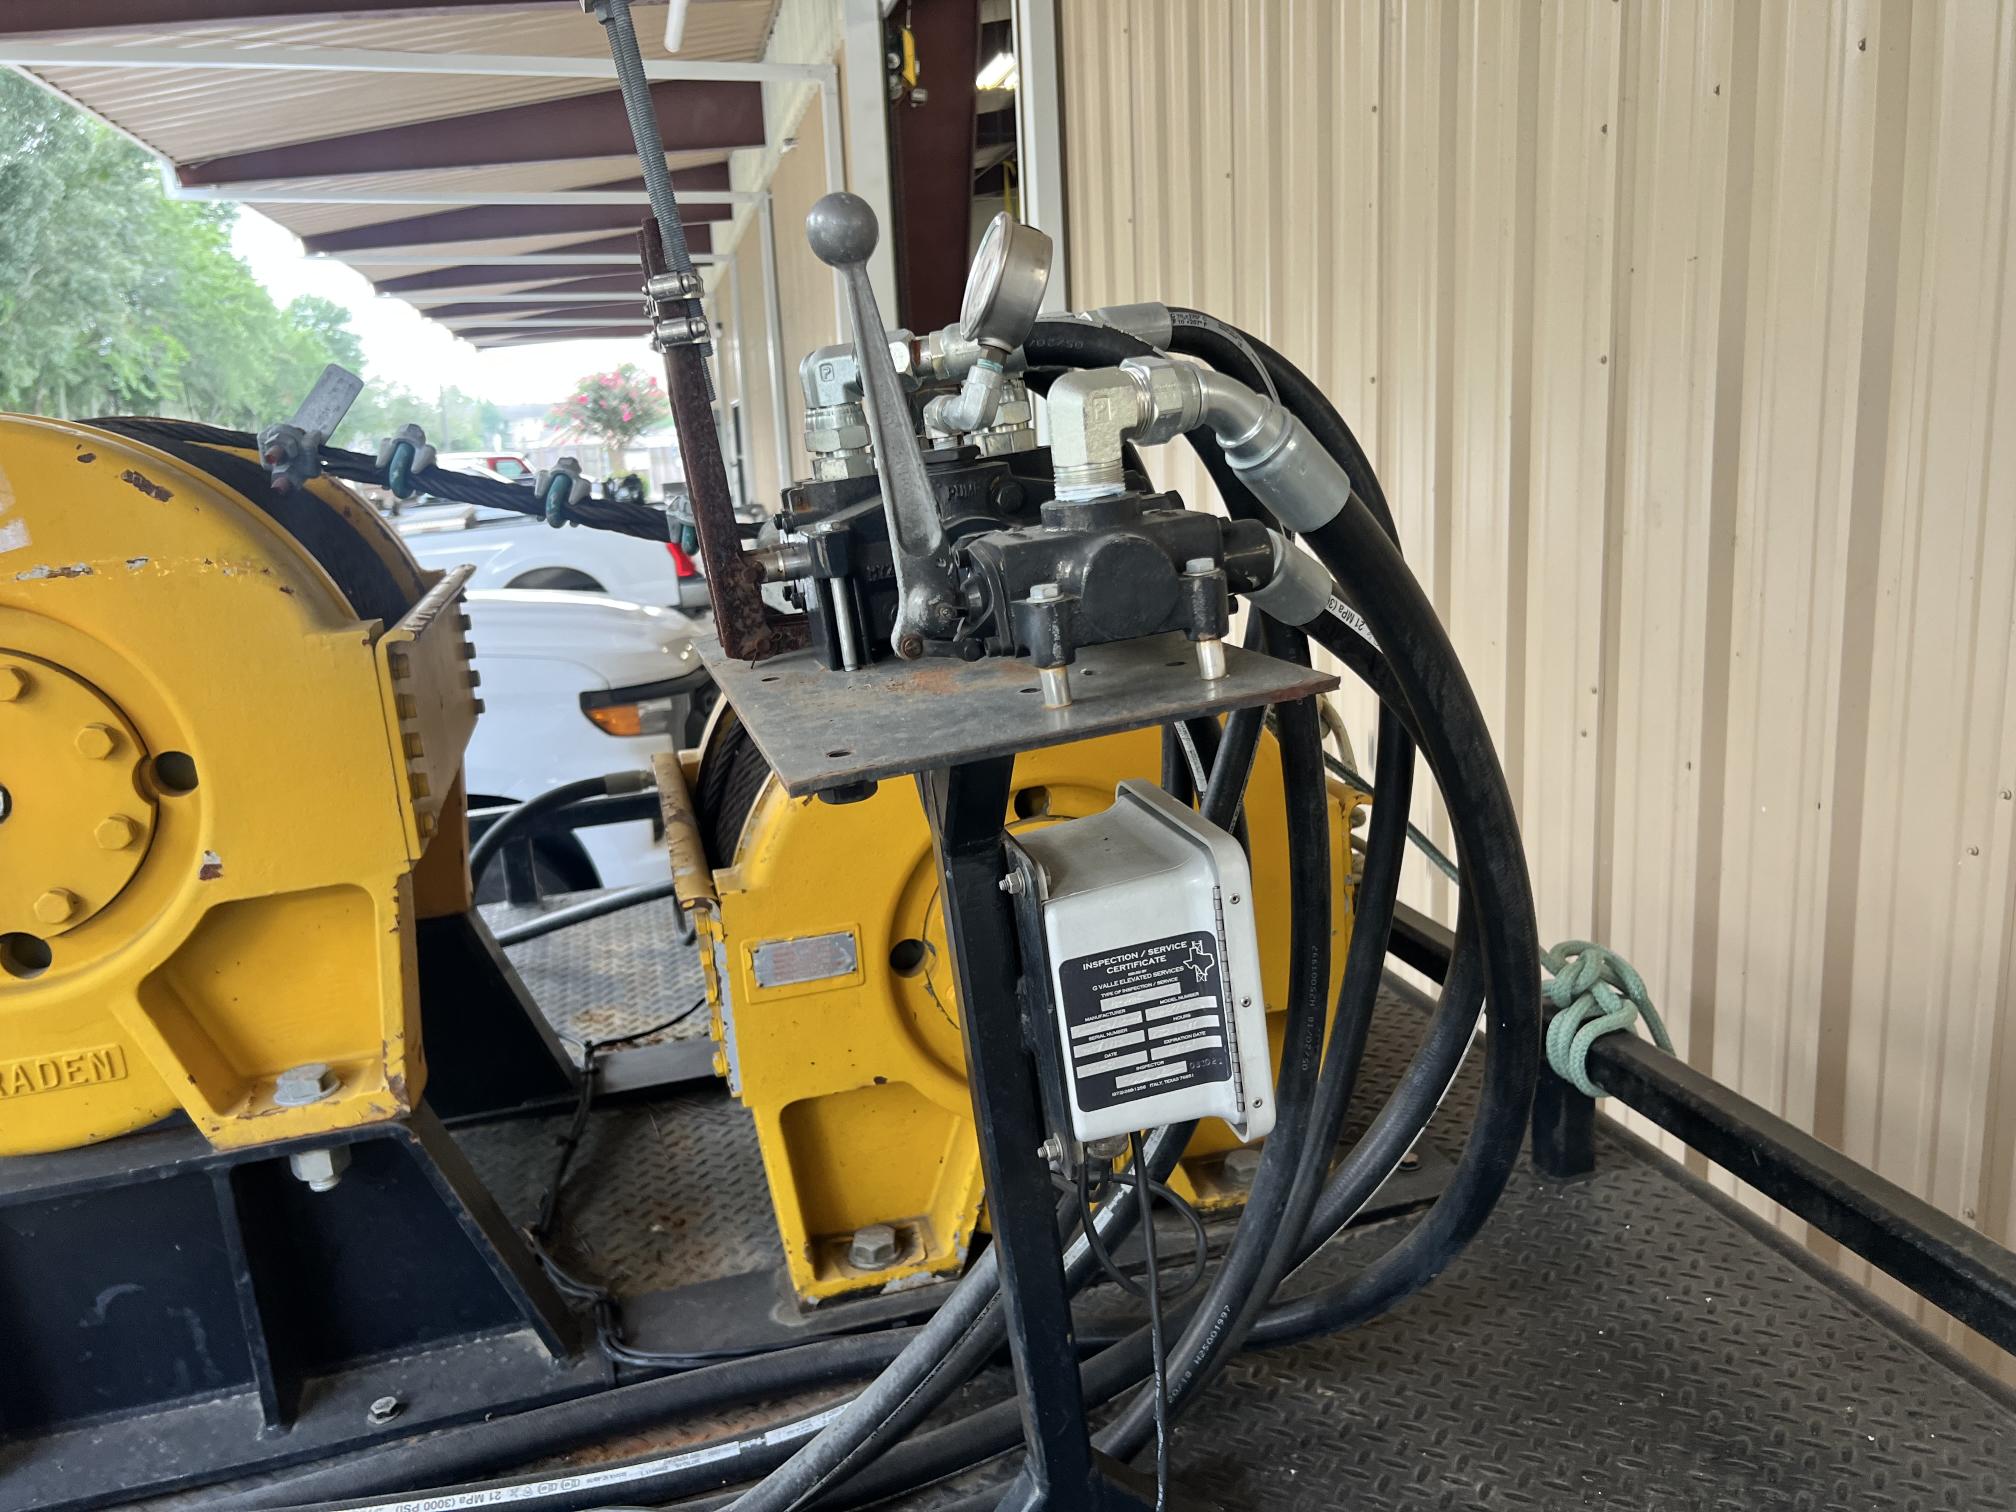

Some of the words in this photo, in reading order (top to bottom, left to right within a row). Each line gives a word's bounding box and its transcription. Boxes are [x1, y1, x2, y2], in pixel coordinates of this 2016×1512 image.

[1327, 597, 1338, 611] (3
[1338, 605, 1355, 623] MPa
[1354, 618, 1366, 631] 21
[1083, 950, 1139, 971] INSPECTION
[1147, 940, 1188, 956] SERVICE
[1106, 955, 1167, 974] CERTIFICATE
[1097, 980, 1119, 991] VALLE
[1119, 972, 1152, 985] ELEVATED
[1152, 965, 1185, 978] SERVICES
[1121, 982, 1153, 994] INSPECTION
[1156, 976, 1179, 987] SERVICE
[1159, 996, 1178, 1005] MODEL
[1177, 991, 1200, 1000] NUMBER
[1084, 1008, 1126, 1022] MANUFACTURER
[1088, 1033, 1106, 1042] SERIAL
[1106, 1028, 1128, 1037] NUMBER
[1163, 1034, 1193, 1045] EXPIRATION
[1192, 1030, 1207, 1038] DATE
[1104, 1051, 1118, 1059] DATE
[1135, 1060, 1165, 1071] INSPECTOR
[458, 1493, 485, 1505] MPa
[488, 1490, 502, 1502] 21
[423, 1497, 457, 1511] (3000
